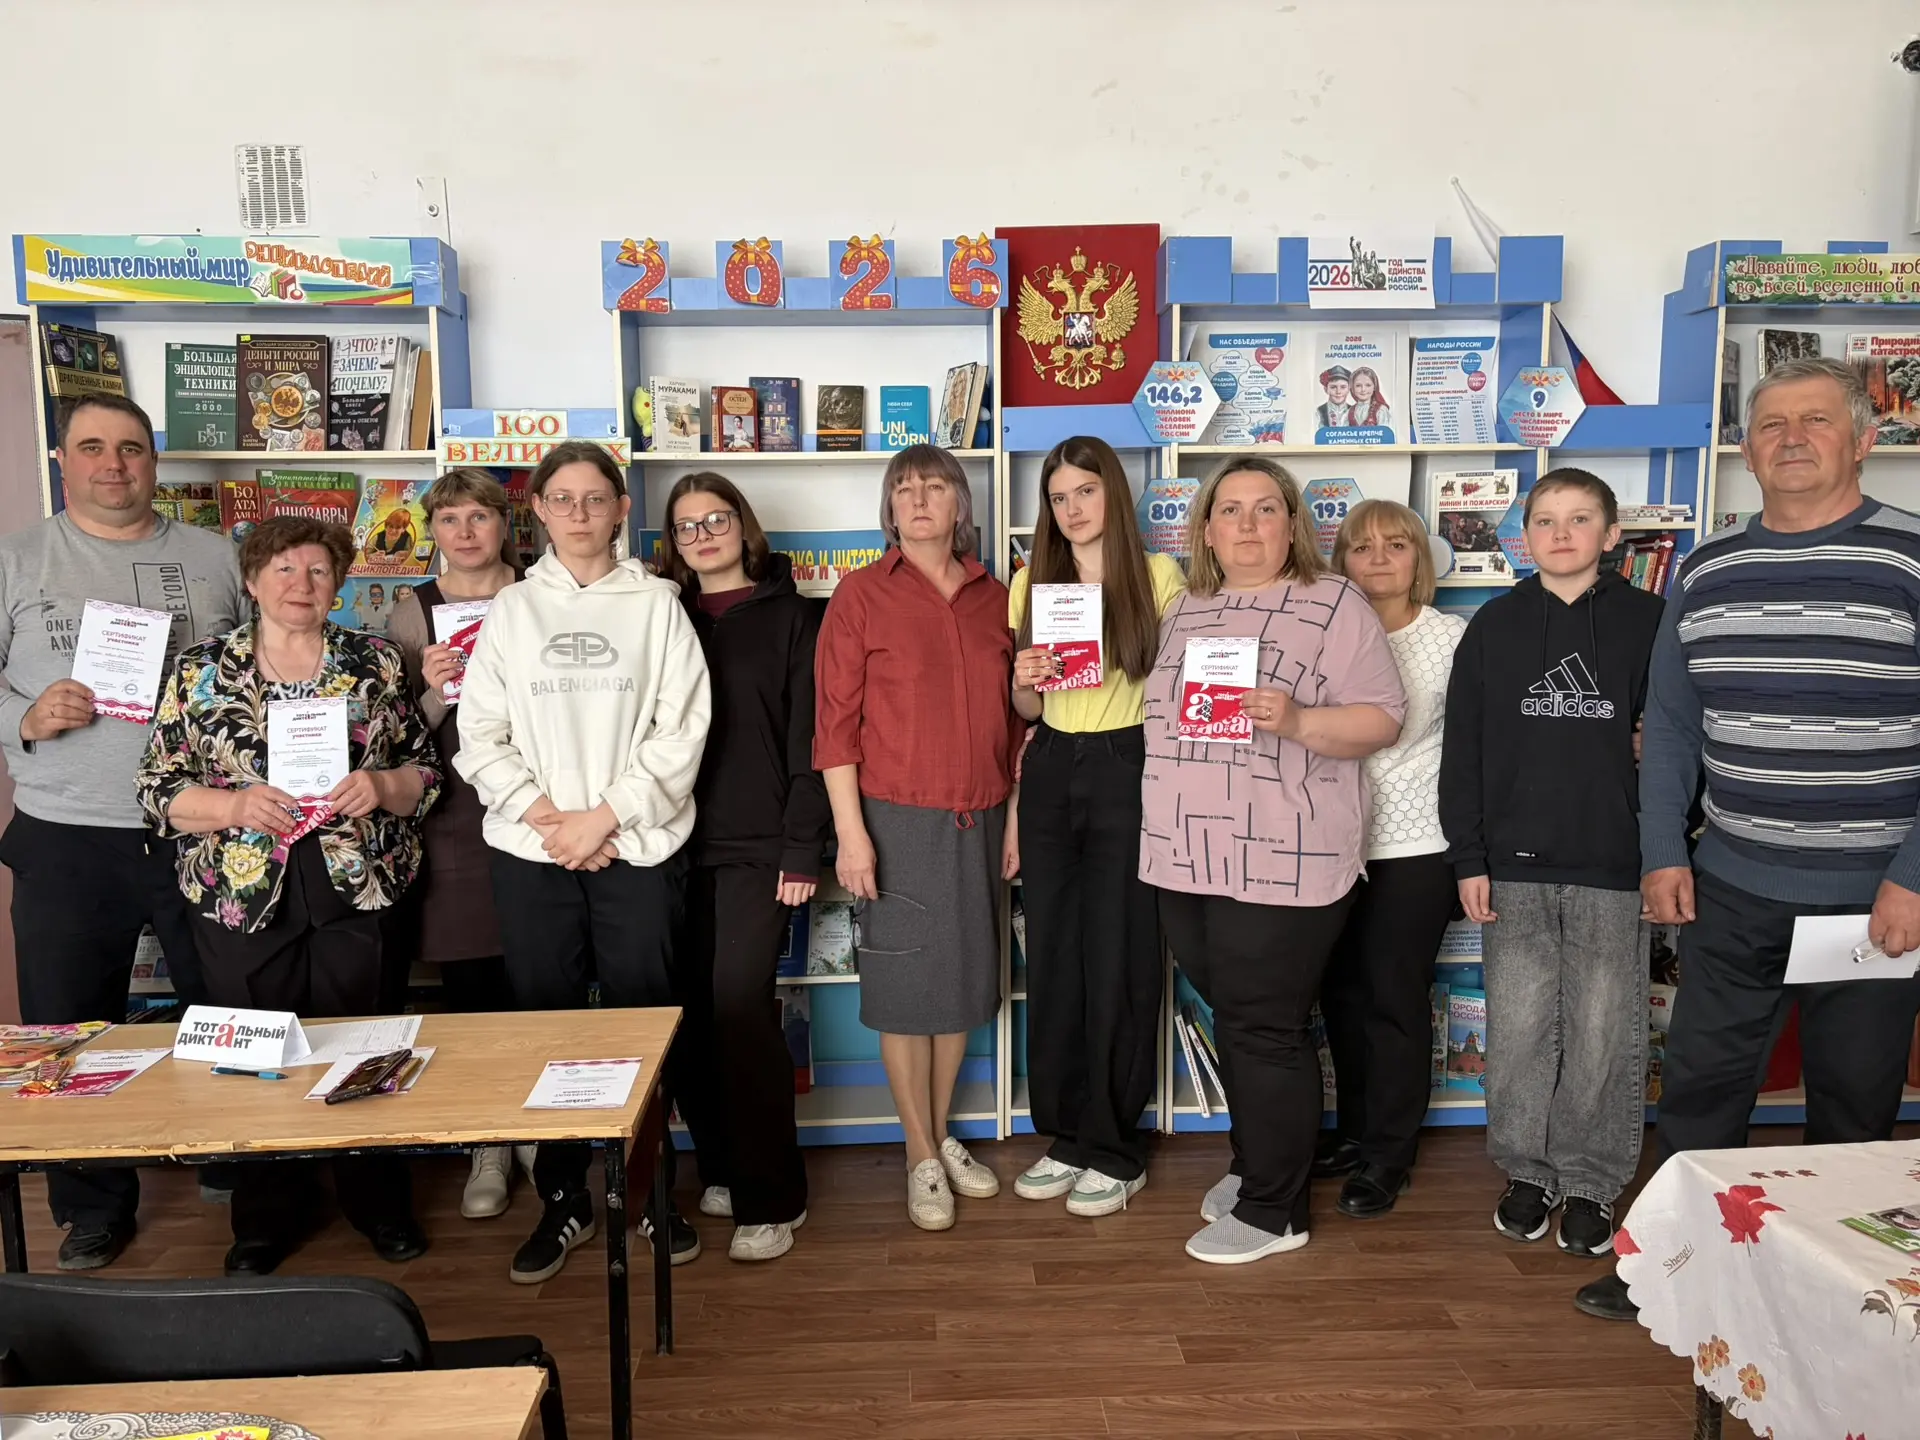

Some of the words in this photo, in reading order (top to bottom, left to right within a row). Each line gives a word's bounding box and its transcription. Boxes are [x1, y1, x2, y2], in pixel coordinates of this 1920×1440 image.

[46, 248, 200, 283] Удивительный
[205, 256, 250, 287] мир
[1388, 258, 1402, 267] ГОД
[1735, 257, 1826, 276] «Давайте,
[1832, 258, 1883, 276] люди,
[1309, 265, 1350, 286] 2026
[1388, 276, 1422, 284] НАРОДОВ
[1736, 281, 1756, 294] во
[1764, 279, 1805, 294] всей
[1814, 278, 1906, 294] вселенной
[352, 338, 378, 352] ЧТО?
[184, 351, 236, 363] БОЛЬШАЯ
[244, 350, 280, 361] ДЕНЬГИ
[284, 350, 320, 360] РОССИИ
[174, 364, 236, 378] ЭНЦИКЛОПЕД
[264, 361, 271, 370] И
[274, 361, 300, 371] МИРА
[340, 357, 379, 372] ЗАЧЕМ?
[184, 378, 236, 390] ТЕХНИКИ
[337, 376, 387, 391] ПОЧЕМУ?
[658, 386, 696, 394] МУРАКАМИ
[1147, 386, 1202, 407] 146,2
[1534, 391, 1545, 408] 9
[498, 416, 560, 436] 100
[880, 420, 906, 434] UNI
[888, 433, 929, 446] CORN
[444, 442, 629, 463] ВЕЛИХ
[1470, 498, 1510, 506] ПОЖАРСКИЙ
[1314, 502, 1348, 518] 193
[351, 564, 420, 575] НЦИКЛОПЕДИЯ
[160, 566, 188, 622] BEYOND
[46, 618, 74, 632] ONE
[530, 677, 635, 696] BALENCIAGA
[1521, 693, 1615, 718] adidas
[1449, 1002, 1486, 1013] ГОРОДА
[1448, 1011, 1486, 1022] РОССИИ
